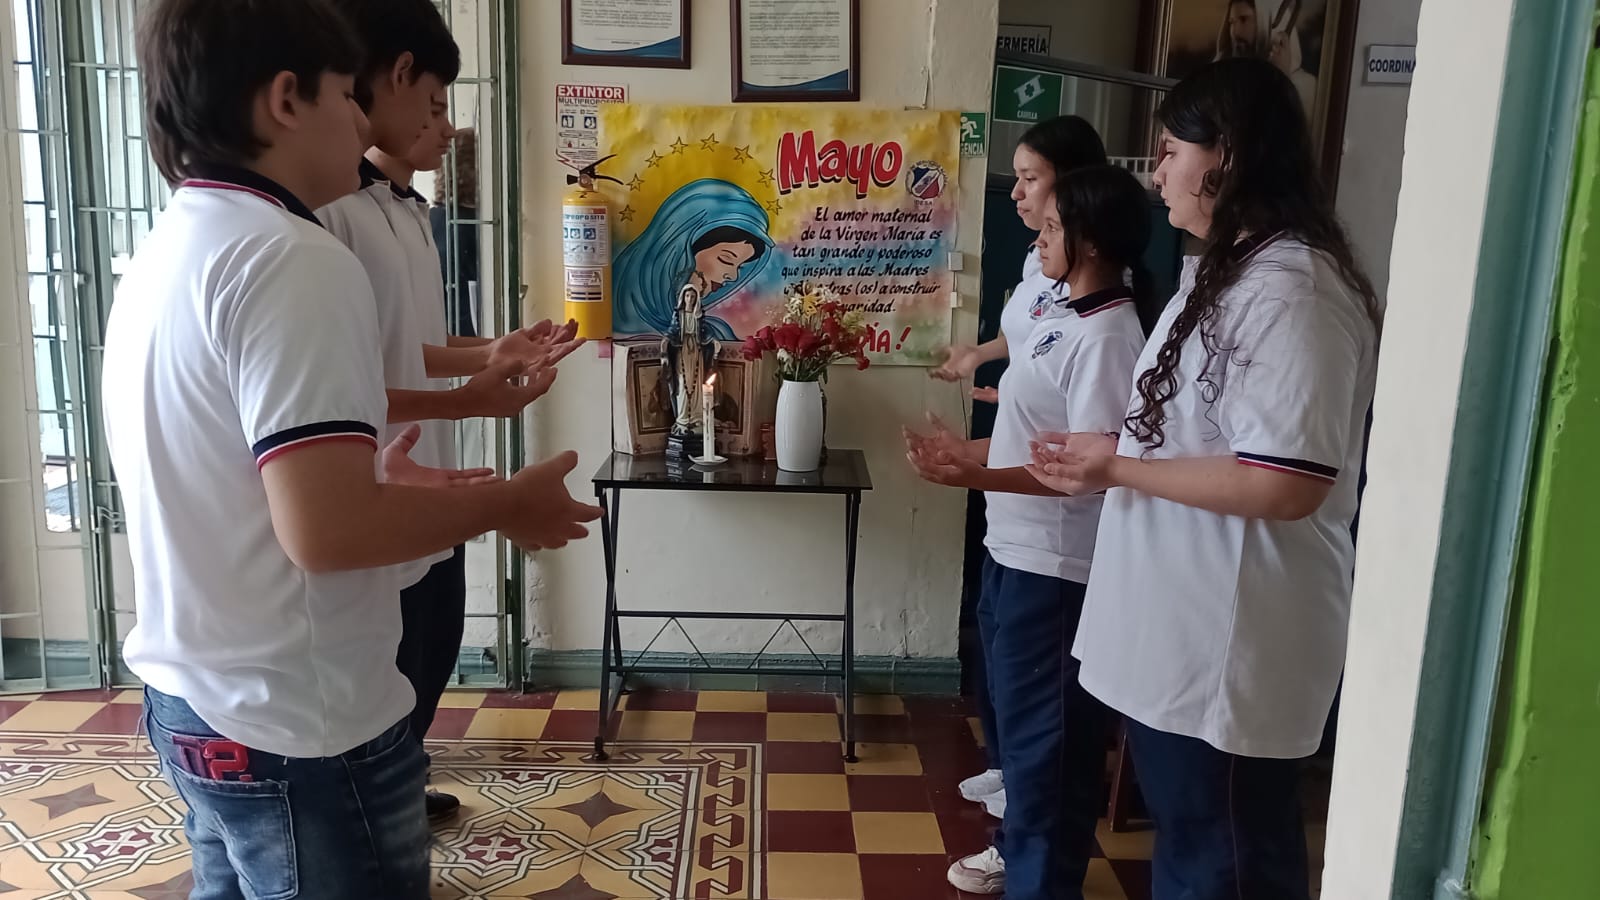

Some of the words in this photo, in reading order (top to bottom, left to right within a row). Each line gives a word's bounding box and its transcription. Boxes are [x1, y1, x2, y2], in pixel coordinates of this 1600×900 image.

[558, 85, 622, 99] EXTINTOR
[777, 129, 904, 200] Mayo
[815, 206, 829, 222] El
[833, 210, 869, 223] amor
[871, 208, 933, 224] maternal
[801, 226, 816, 241] de
[819, 226, 831, 241] la
[835, 225, 879, 245] Virgen
[882, 225, 925, 241] María
[929, 229, 943, 240] es
[792, 245, 815, 258] tan
[820, 244, 865, 262] grande
[866, 248, 875, 262] y
[877, 245, 933, 261] poderoso
[781, 265, 799, 279] que
[802, 263, 843, 279] inspira
[847, 266, 855, 277] a
[857, 264, 875, 277] las
[878, 263, 930, 277] Madres
[855, 281, 878, 296] (os)
[879, 283, 889, 295] a
[889, 281, 941, 296] construir
